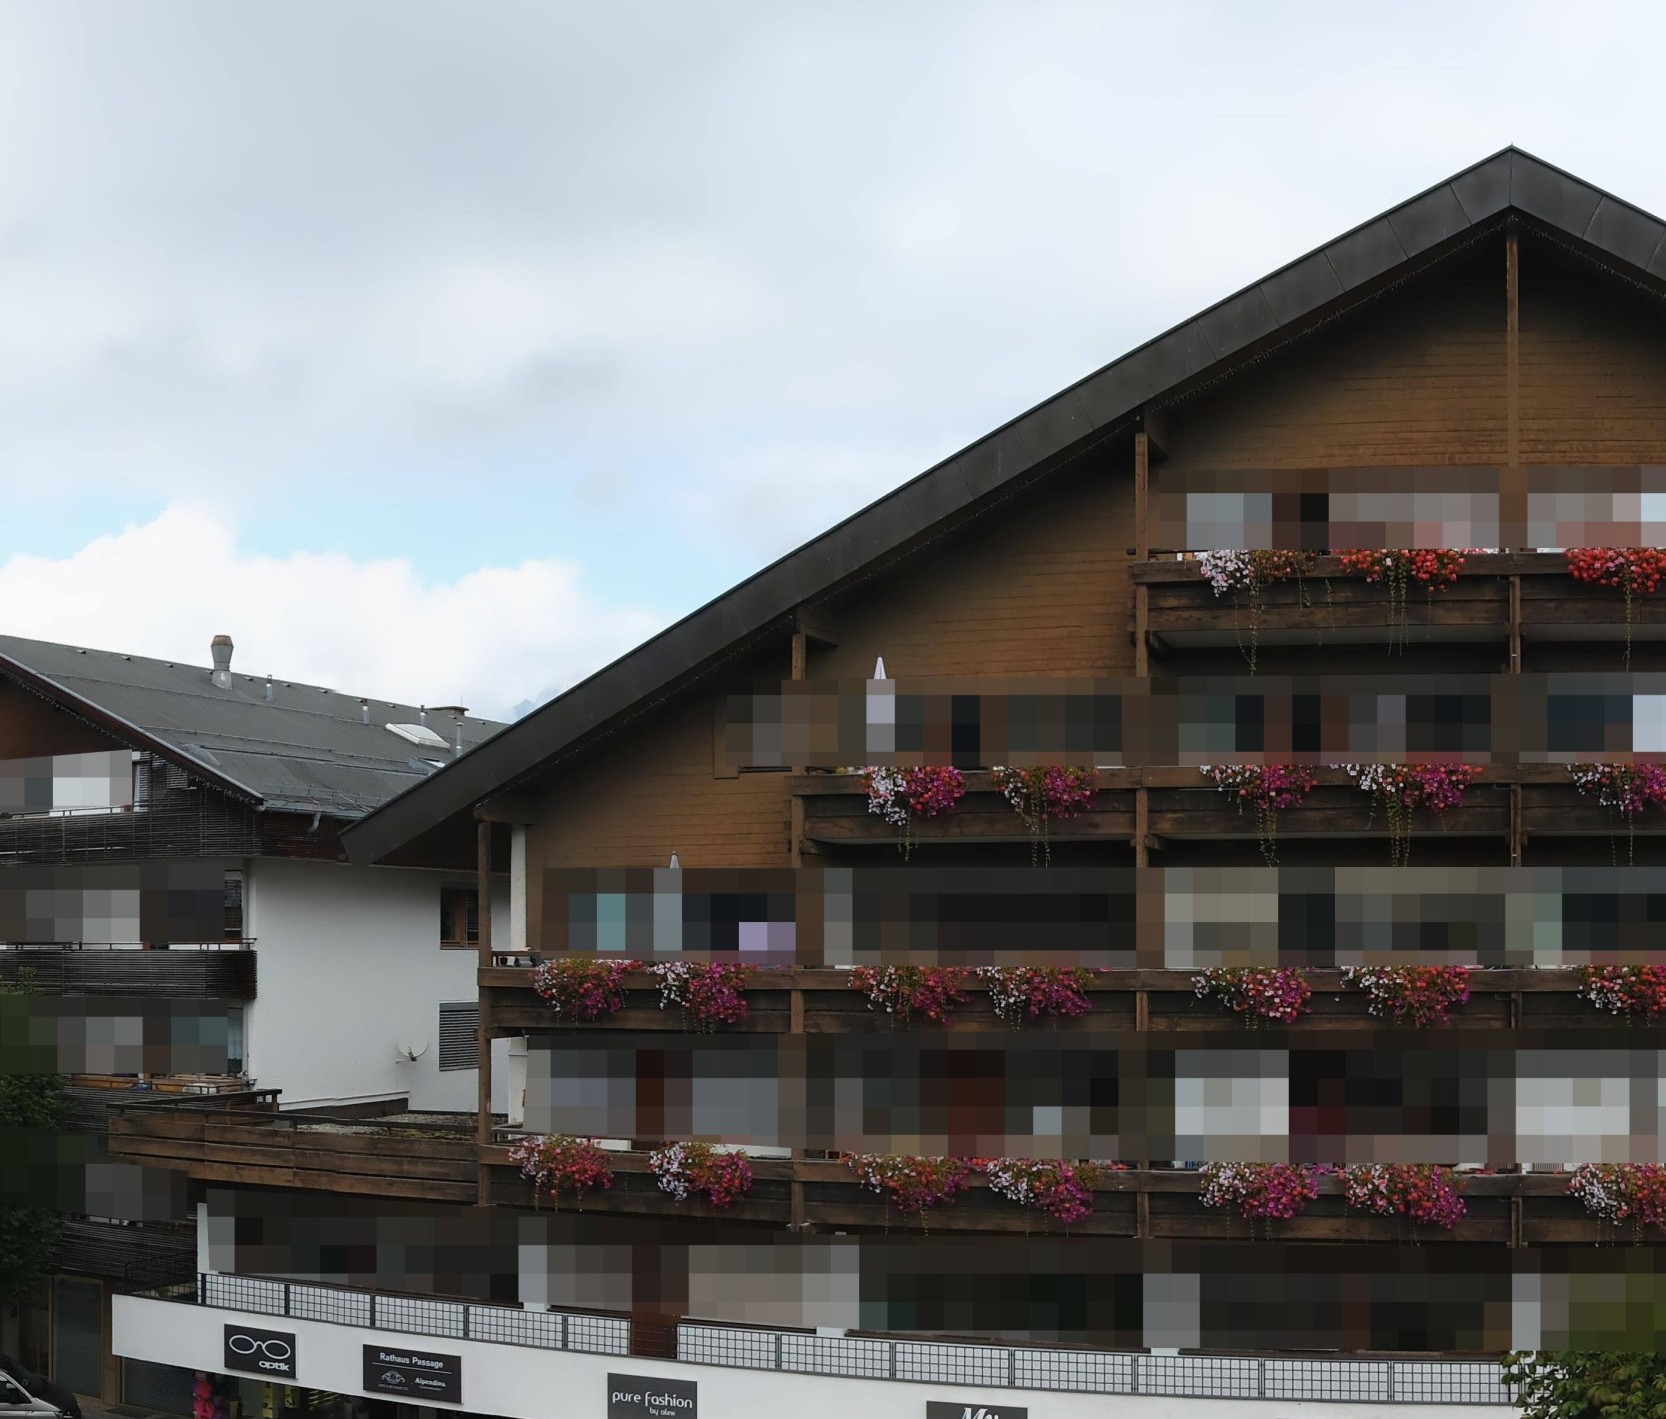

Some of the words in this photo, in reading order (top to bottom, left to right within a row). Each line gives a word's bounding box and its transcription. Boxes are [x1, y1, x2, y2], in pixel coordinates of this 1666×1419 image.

[258, 1359, 290, 1372] optik
[379, 1352, 410, 1364] Rathaus
[411, 1356, 444, 1369] Passage
[612, 1391, 641, 1403] pure
[645, 1391, 693, 1408] fashion
[649, 1407, 659, 1416] by
